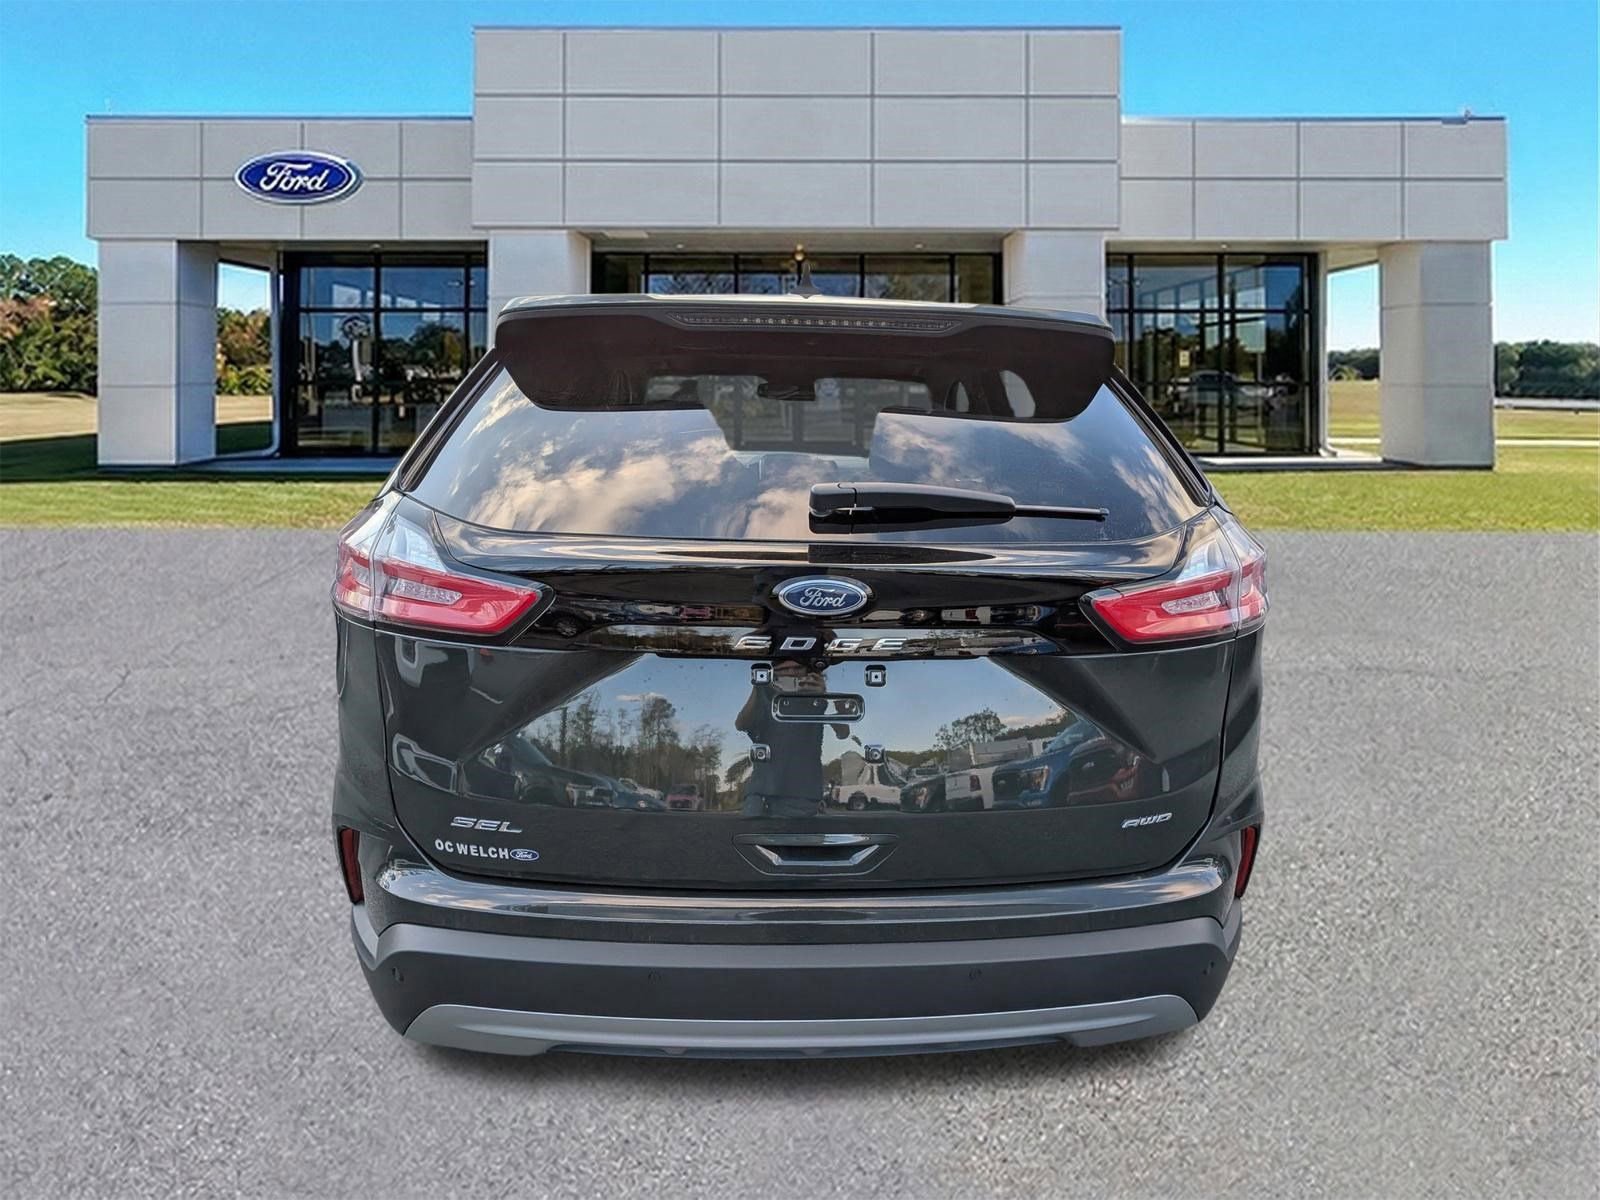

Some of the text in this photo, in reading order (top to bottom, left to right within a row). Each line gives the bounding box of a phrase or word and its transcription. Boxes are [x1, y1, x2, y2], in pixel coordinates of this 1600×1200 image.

[260, 161, 330, 191] Ford
[800, 586, 846, 608] Ford
[734, 635, 908, 651] EDGE
[450, 816, 523, 834] SEL
[1121, 811, 1173, 829] AWD
[434, 838, 454, 853] OC
[456, 842, 509, 860] WELCH
